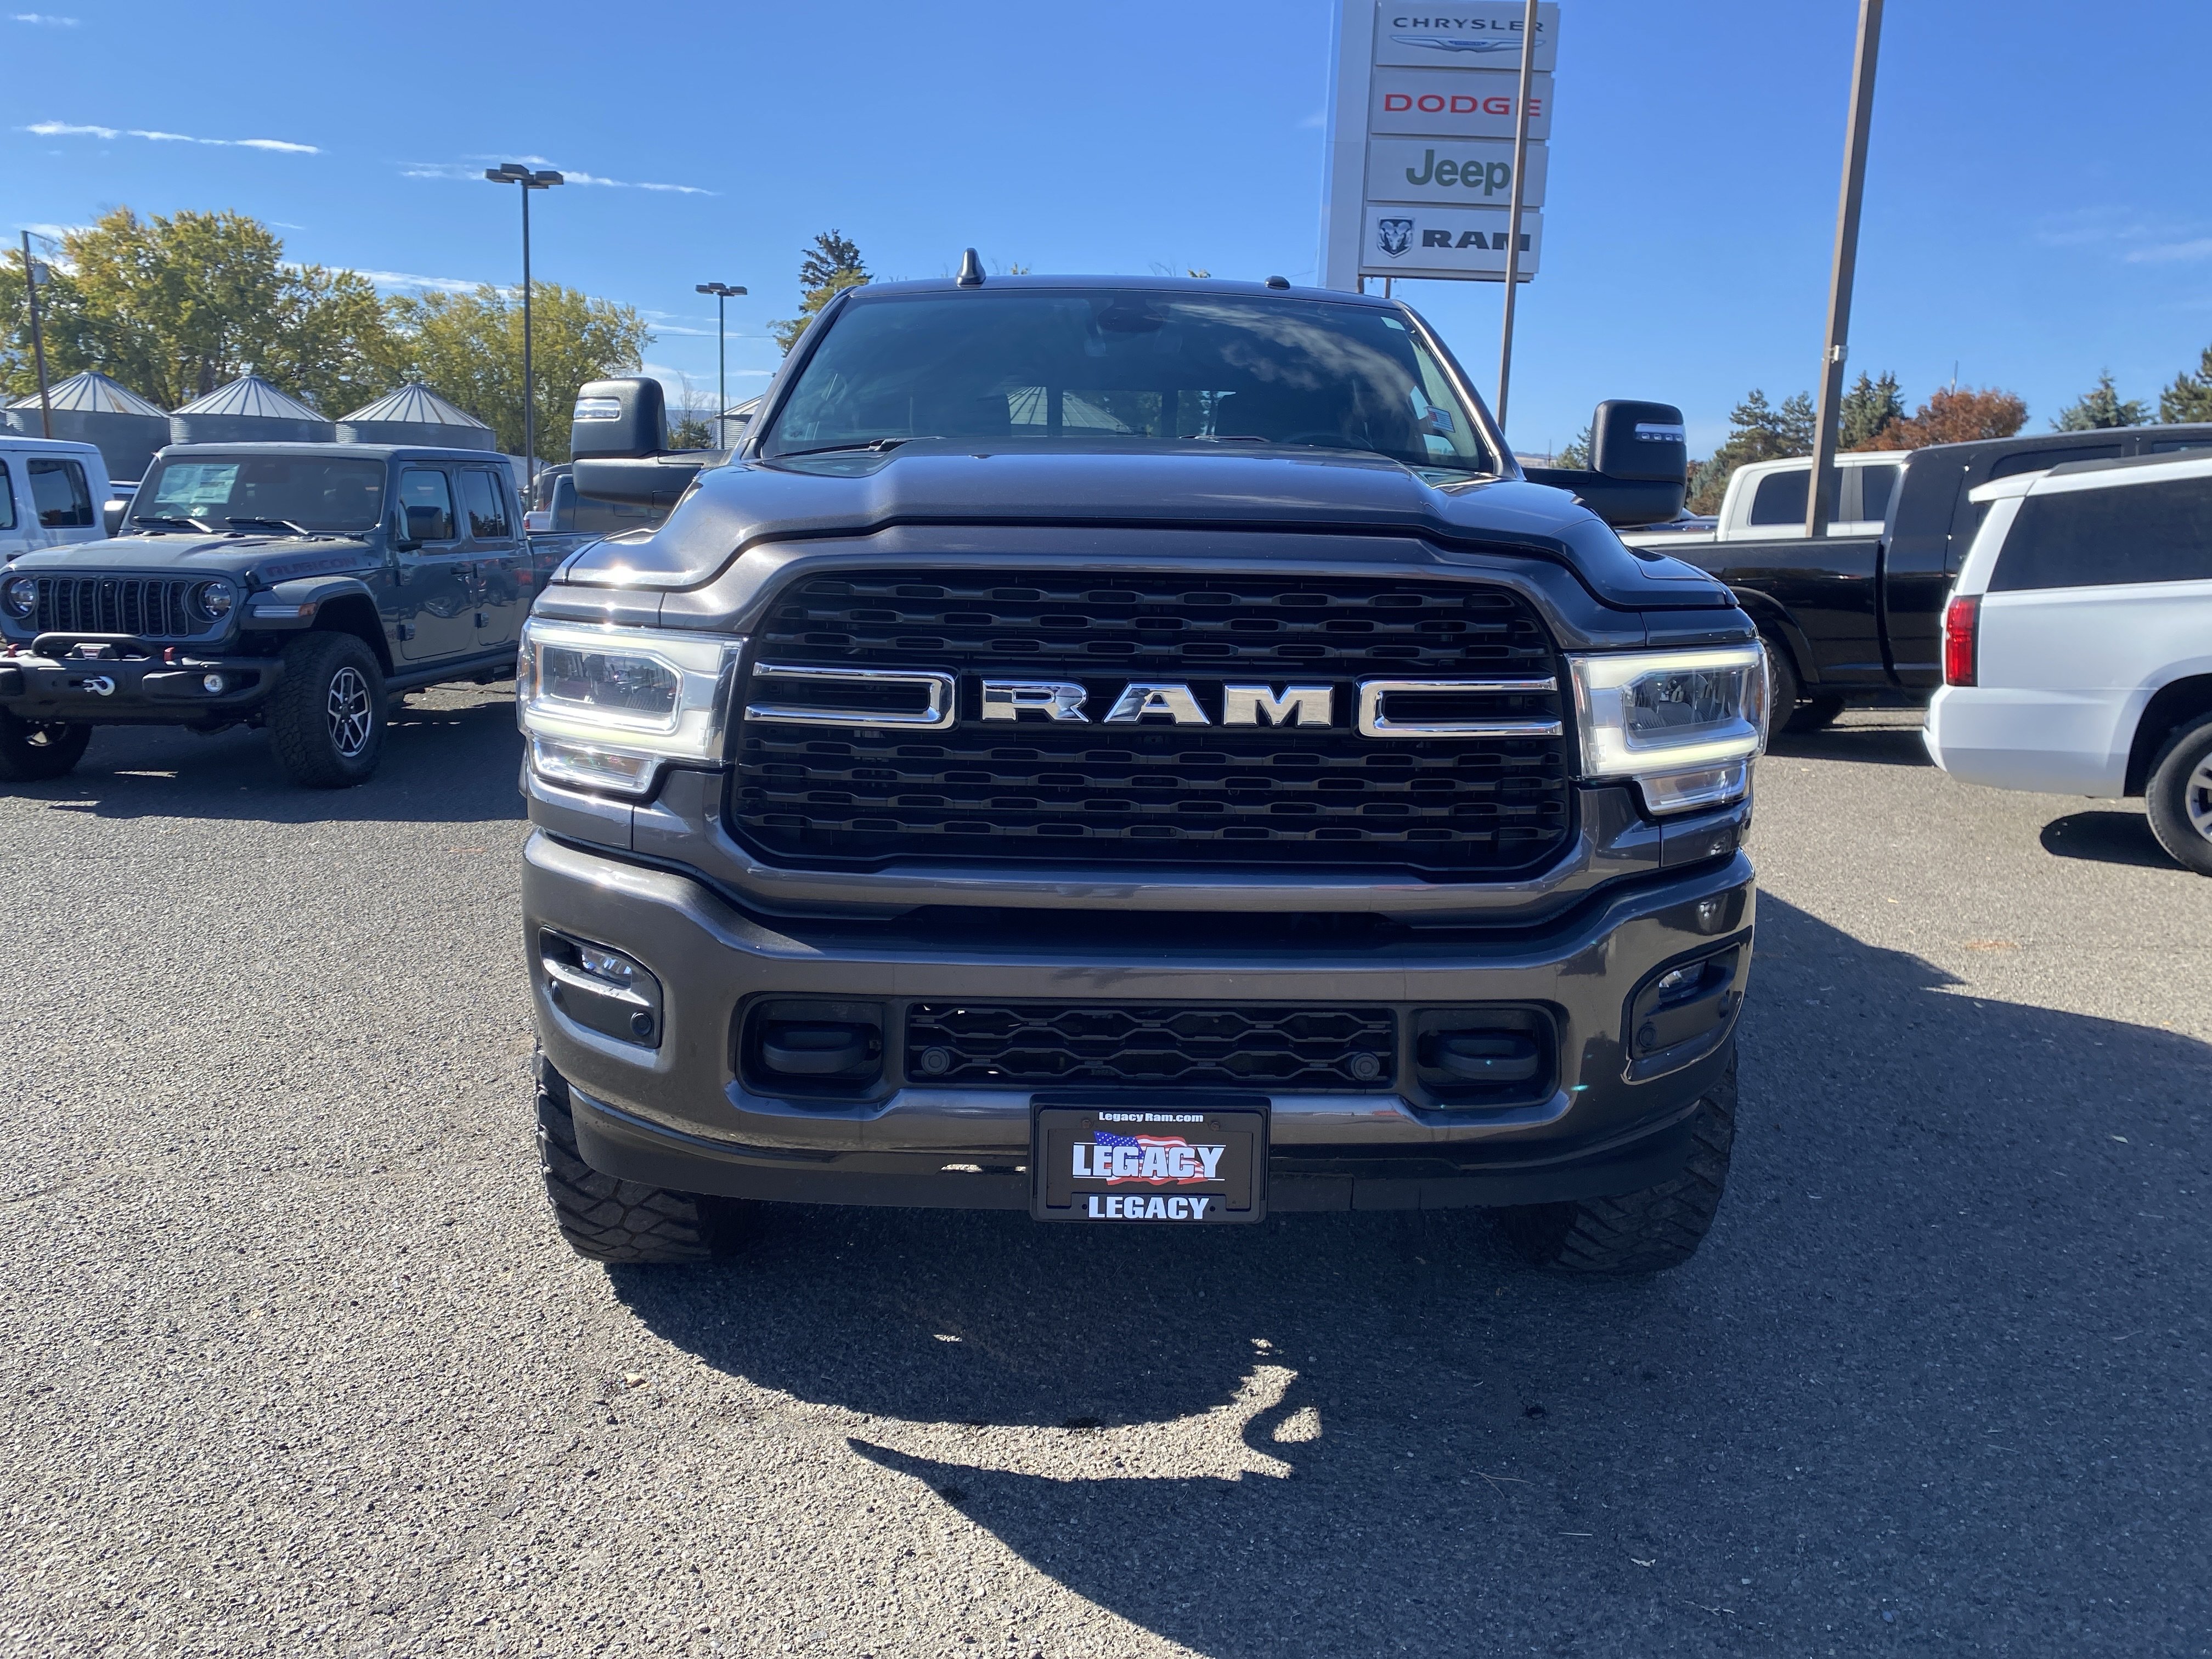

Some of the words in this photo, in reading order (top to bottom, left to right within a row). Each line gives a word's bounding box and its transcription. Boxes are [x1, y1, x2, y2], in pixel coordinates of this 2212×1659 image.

[1393, 17, 1544, 32] CHRYSLER
[1384, 94, 1541, 117] DODGE
[1406, 149, 1511, 196] Jeep
[1421, 229, 1531, 251] RAM
[981, 679, 1334, 726] RAM
[1072, 1144, 1225, 1178] LEGACY
[1088, 1195, 1210, 1220] LEGACY
